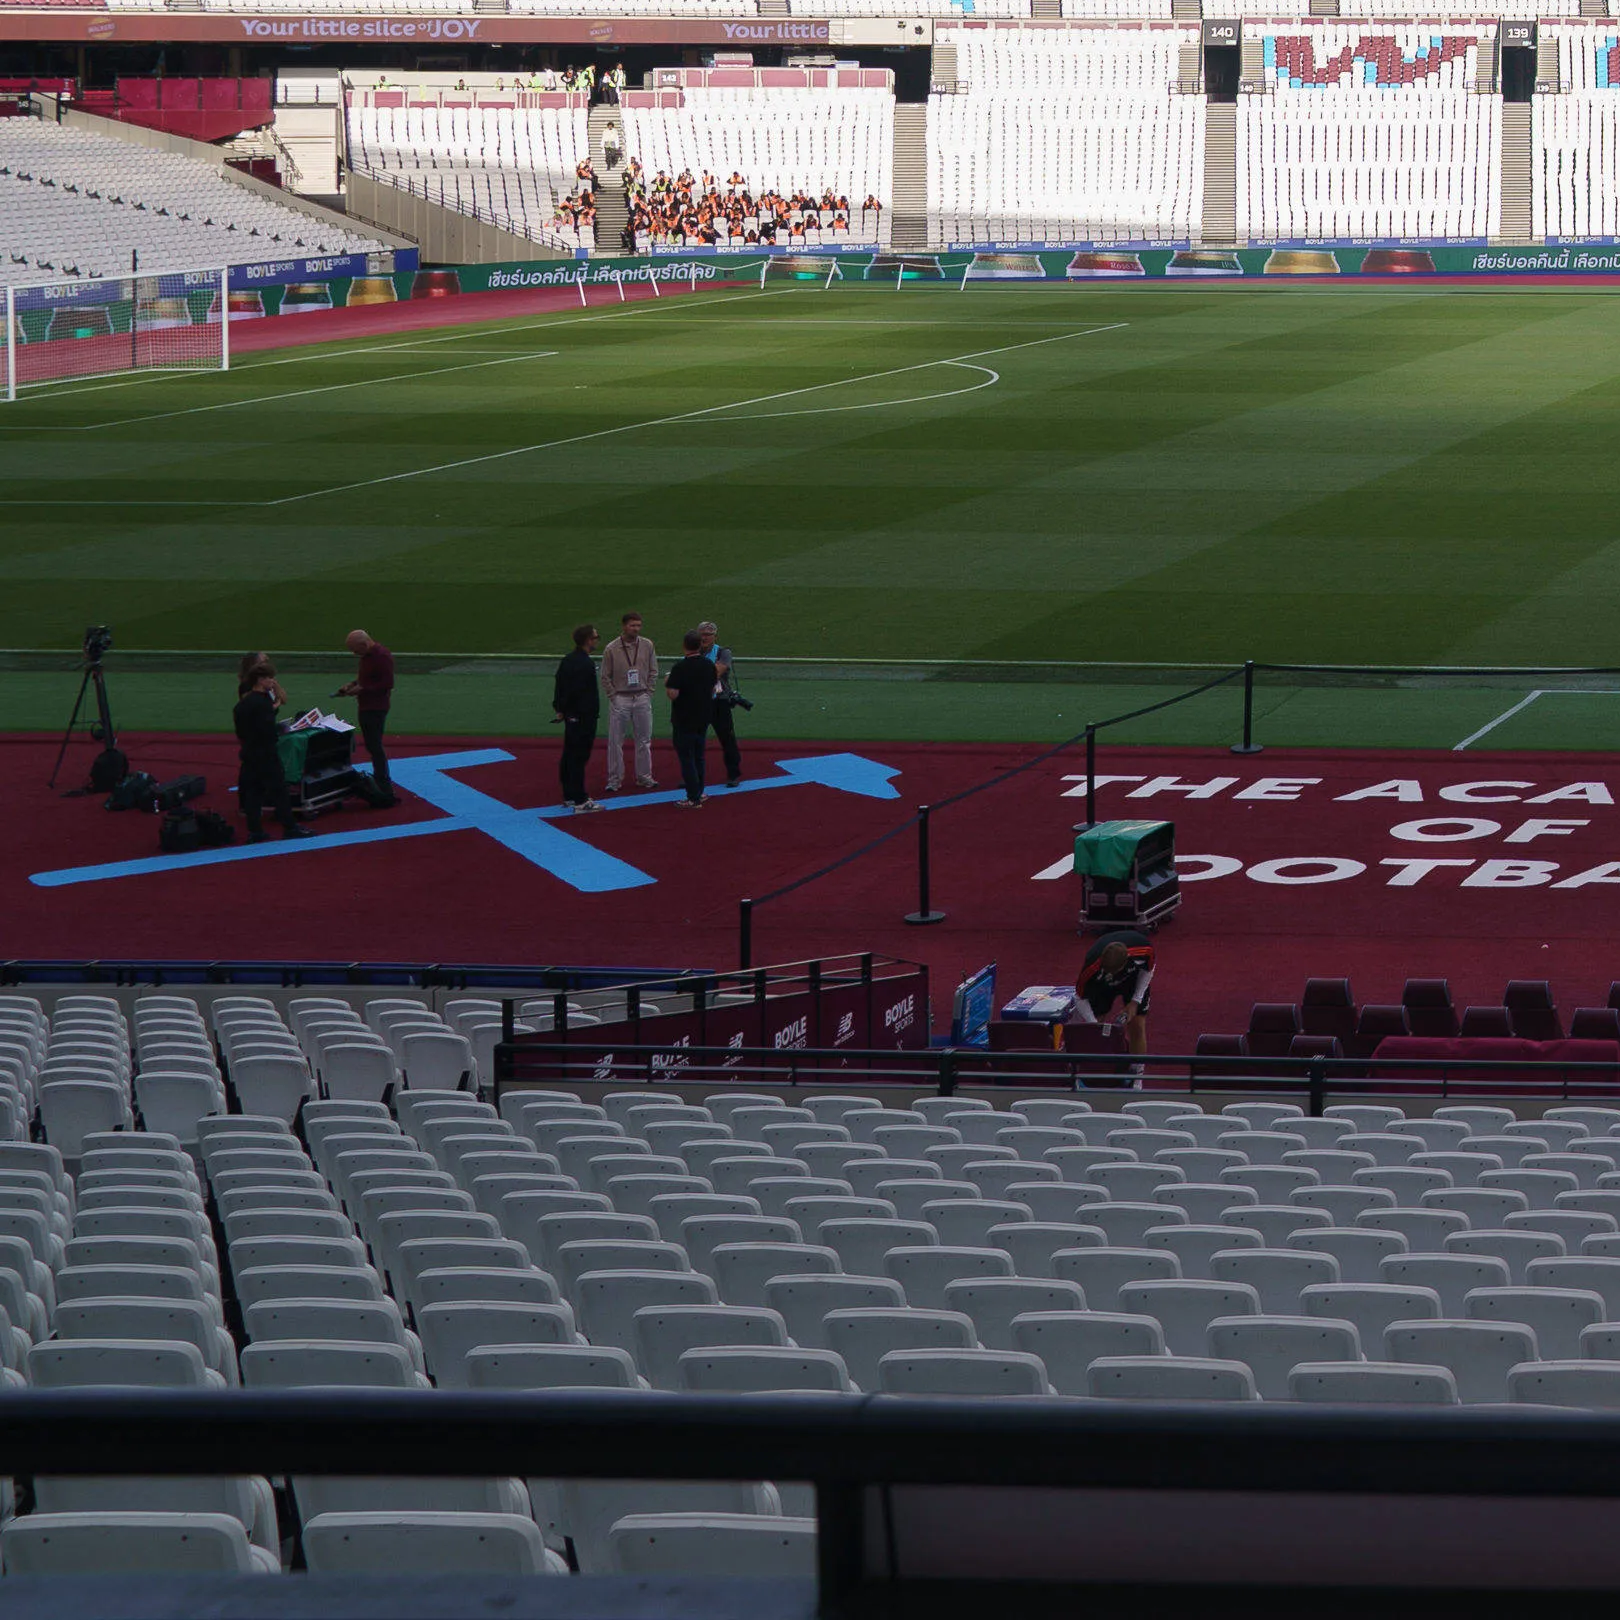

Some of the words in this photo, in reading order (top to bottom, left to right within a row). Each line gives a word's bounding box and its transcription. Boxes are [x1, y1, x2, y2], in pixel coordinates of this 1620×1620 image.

[240, 20, 299, 36] Your
[302, 19, 360, 36] little
[363, 19, 416, 37] slice
[418, 21, 433, 33] of
[430, 20, 481, 37] JOY
[722, 23, 774, 39] Your
[777, 23, 829, 39] little
[1211, 27, 1233, 37] 140
[1508, 28, 1528, 38] 139
[305, 260, 333, 273] BOYLE
[333, 256, 351, 267] SPORTS
[1473, 248, 1570, 269] เชียร์บอลคืนนี้
[184, 270, 215, 285] BOYLE
[246, 266, 276, 278] BOYLE
[276, 262, 295, 273] SPORTS
[44, 285, 79, 299] BOYLE
[1060, 774, 1324, 800] THE
[1389, 817, 1592, 842] OF
[885, 995, 914, 1027] BOYLE
[775, 1016, 807, 1049] BOYLE
